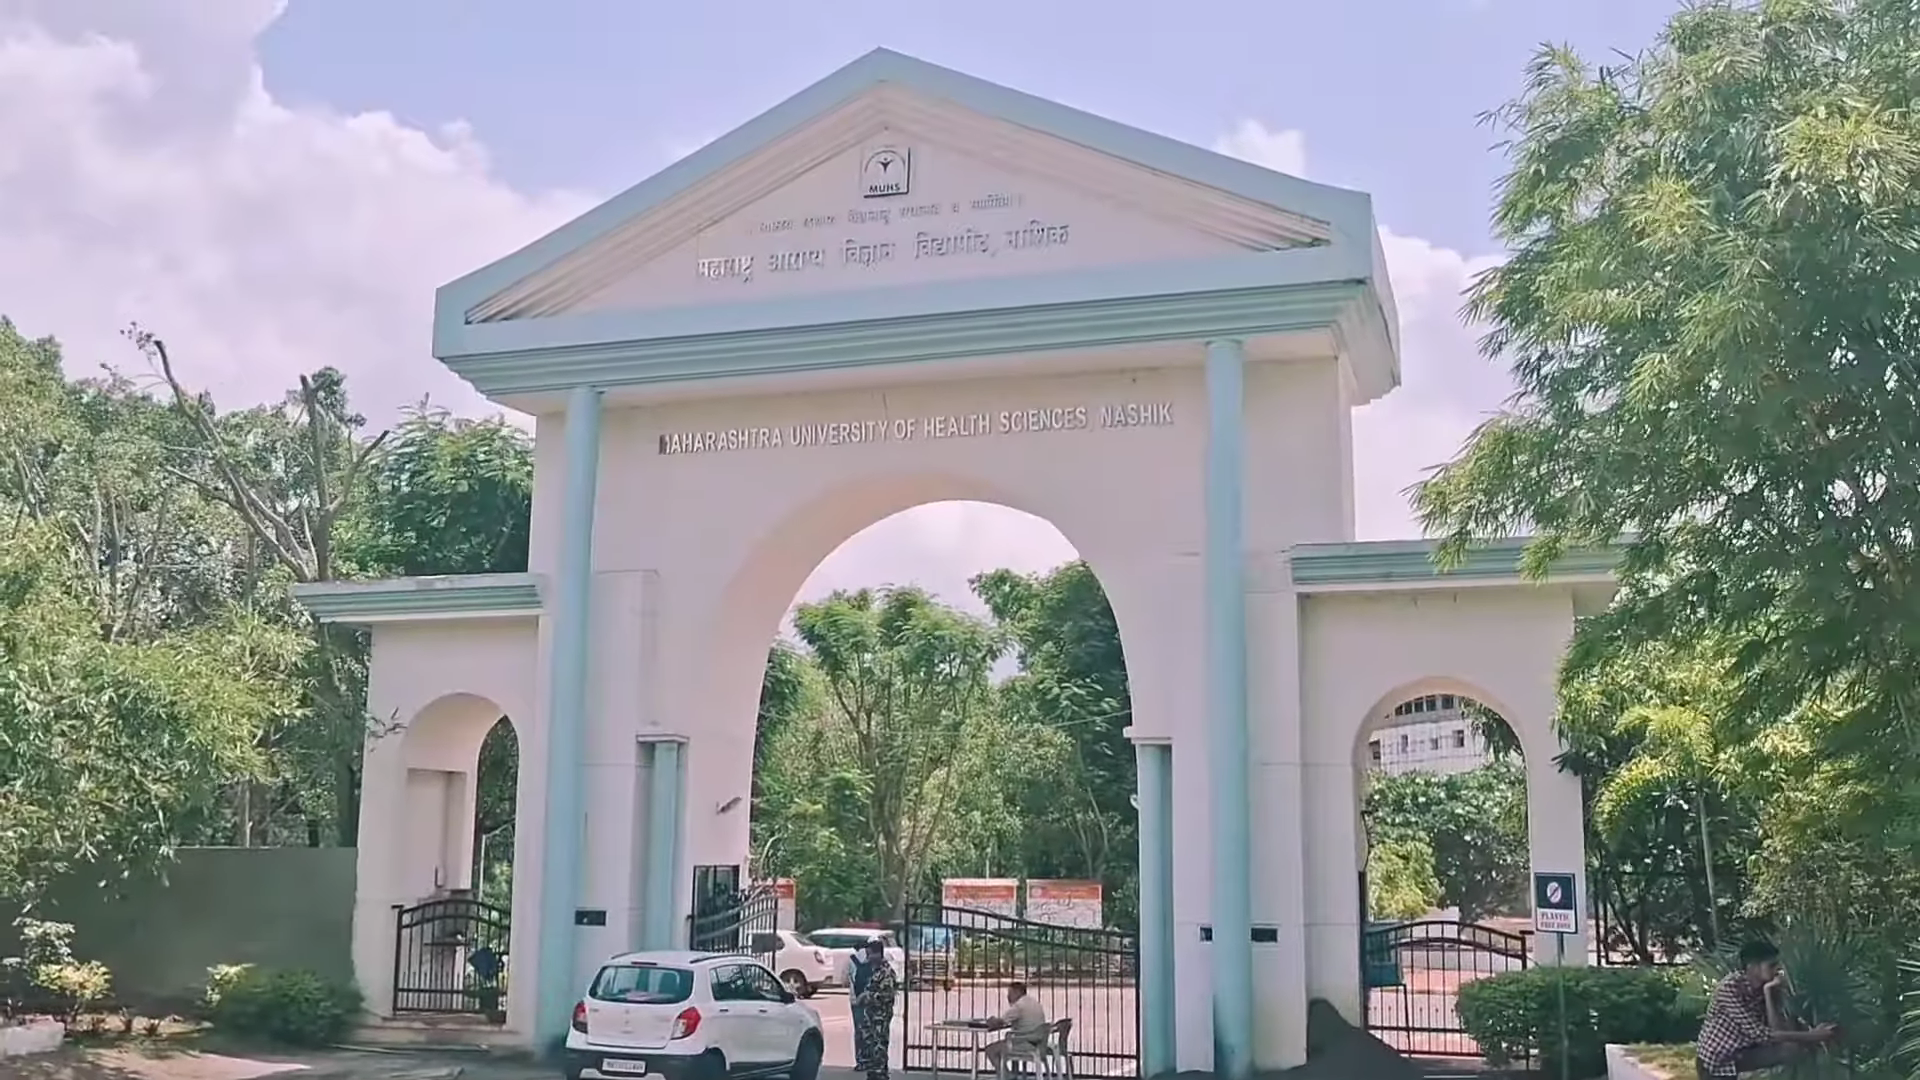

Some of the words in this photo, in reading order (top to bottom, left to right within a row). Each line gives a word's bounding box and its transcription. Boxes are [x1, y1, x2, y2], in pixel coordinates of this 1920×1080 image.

[869, 183, 901, 193] MUHS
[1005, 219, 1070, 250] नाशिक
[790, 419, 888, 447] UNIVERSITY
[894, 418, 916, 441] OF
[924, 413, 991, 439] HEALTH
[1101, 401, 1174, 428] NASHIK
